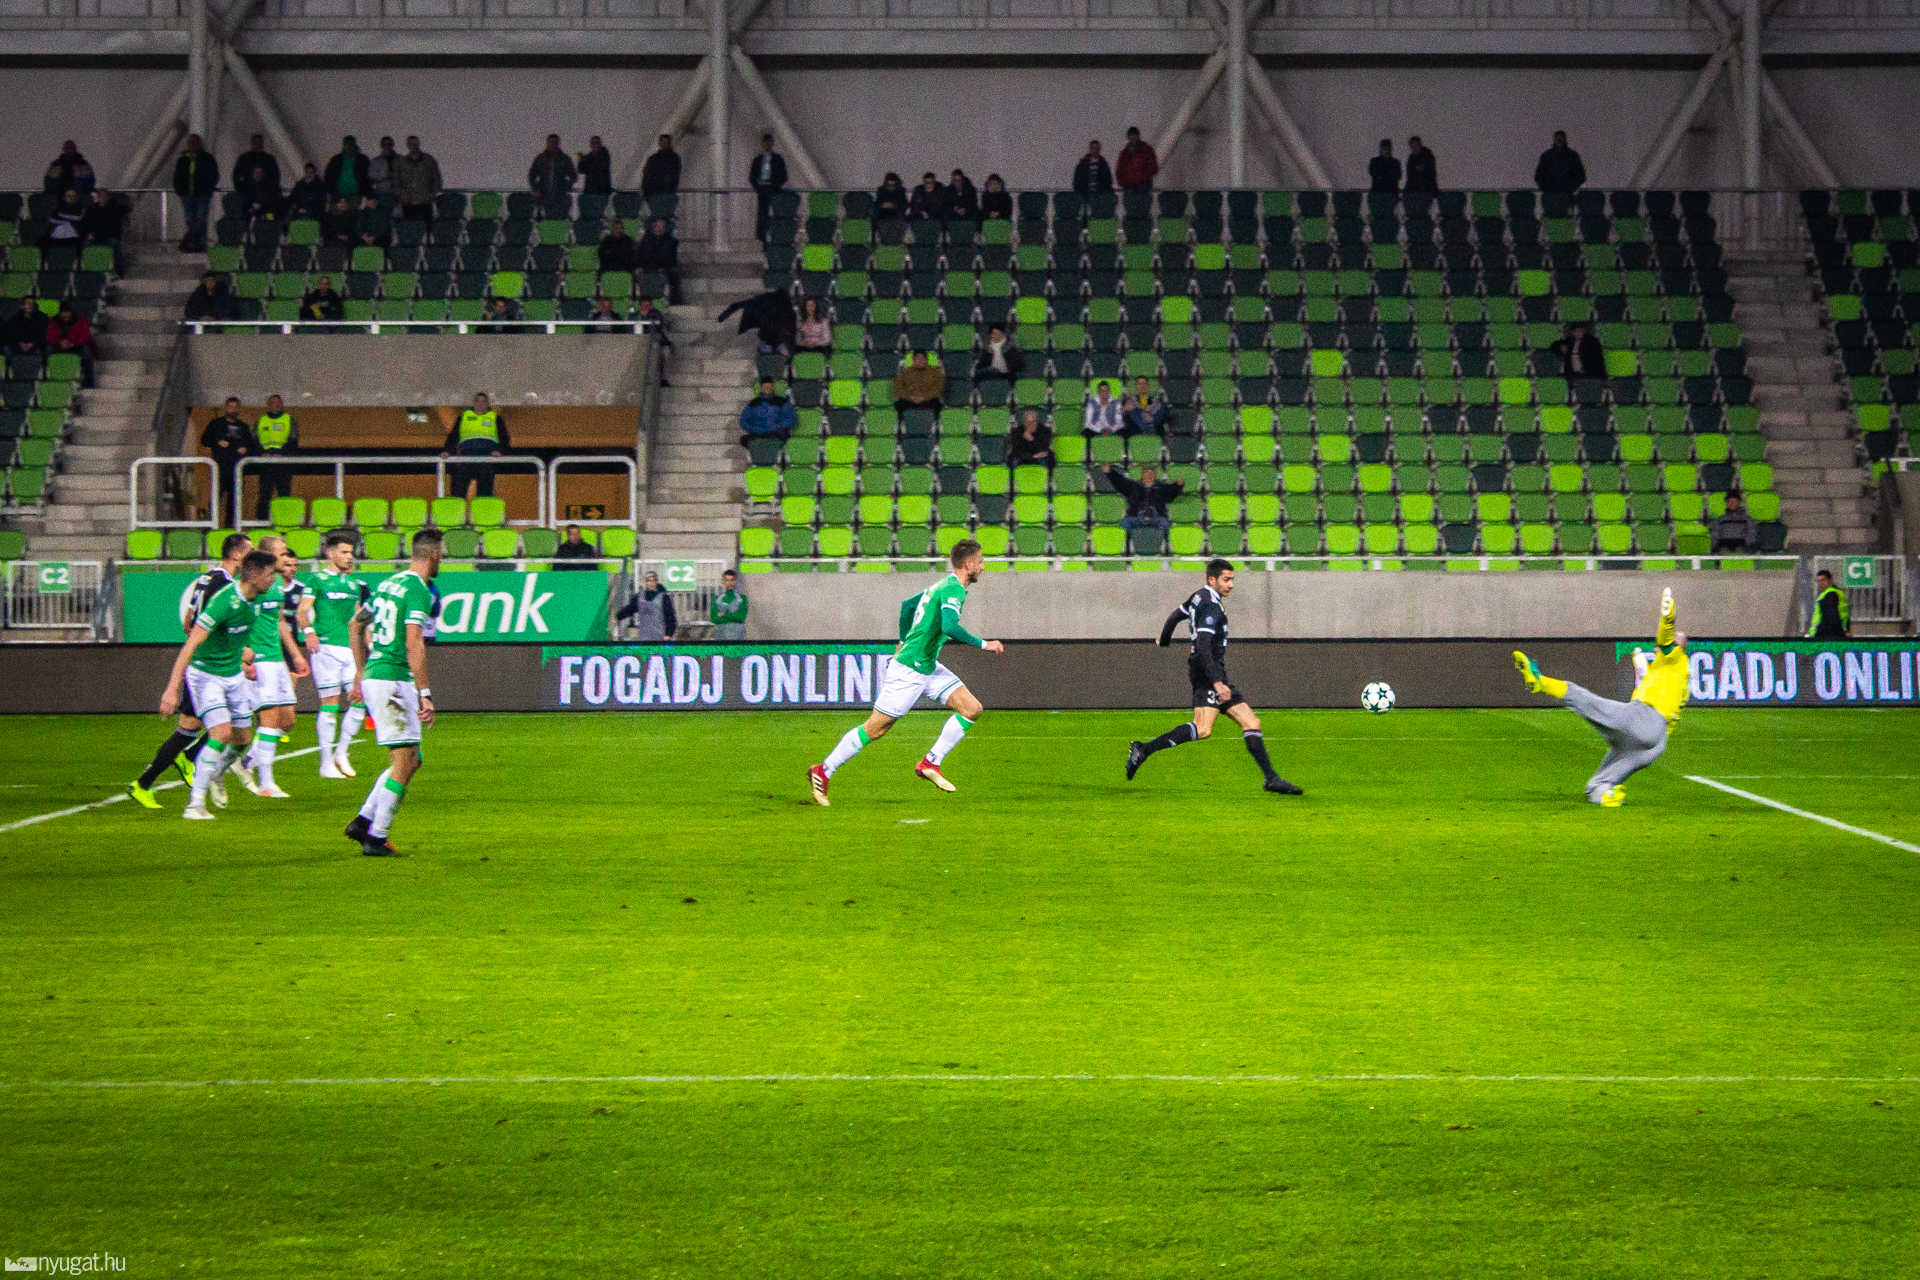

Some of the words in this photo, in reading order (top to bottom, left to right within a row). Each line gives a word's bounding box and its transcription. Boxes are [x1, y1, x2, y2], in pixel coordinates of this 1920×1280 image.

[39, 566, 70, 585] C2
[666, 565, 696, 583] C2
[1847, 561, 1872, 579] C1
[435, 572, 555, 634] ank
[559, 653, 725, 705] FOGADJ
[1635, 650, 1799, 702] GADJ
[1813, 650, 1920, 702] ONLI
